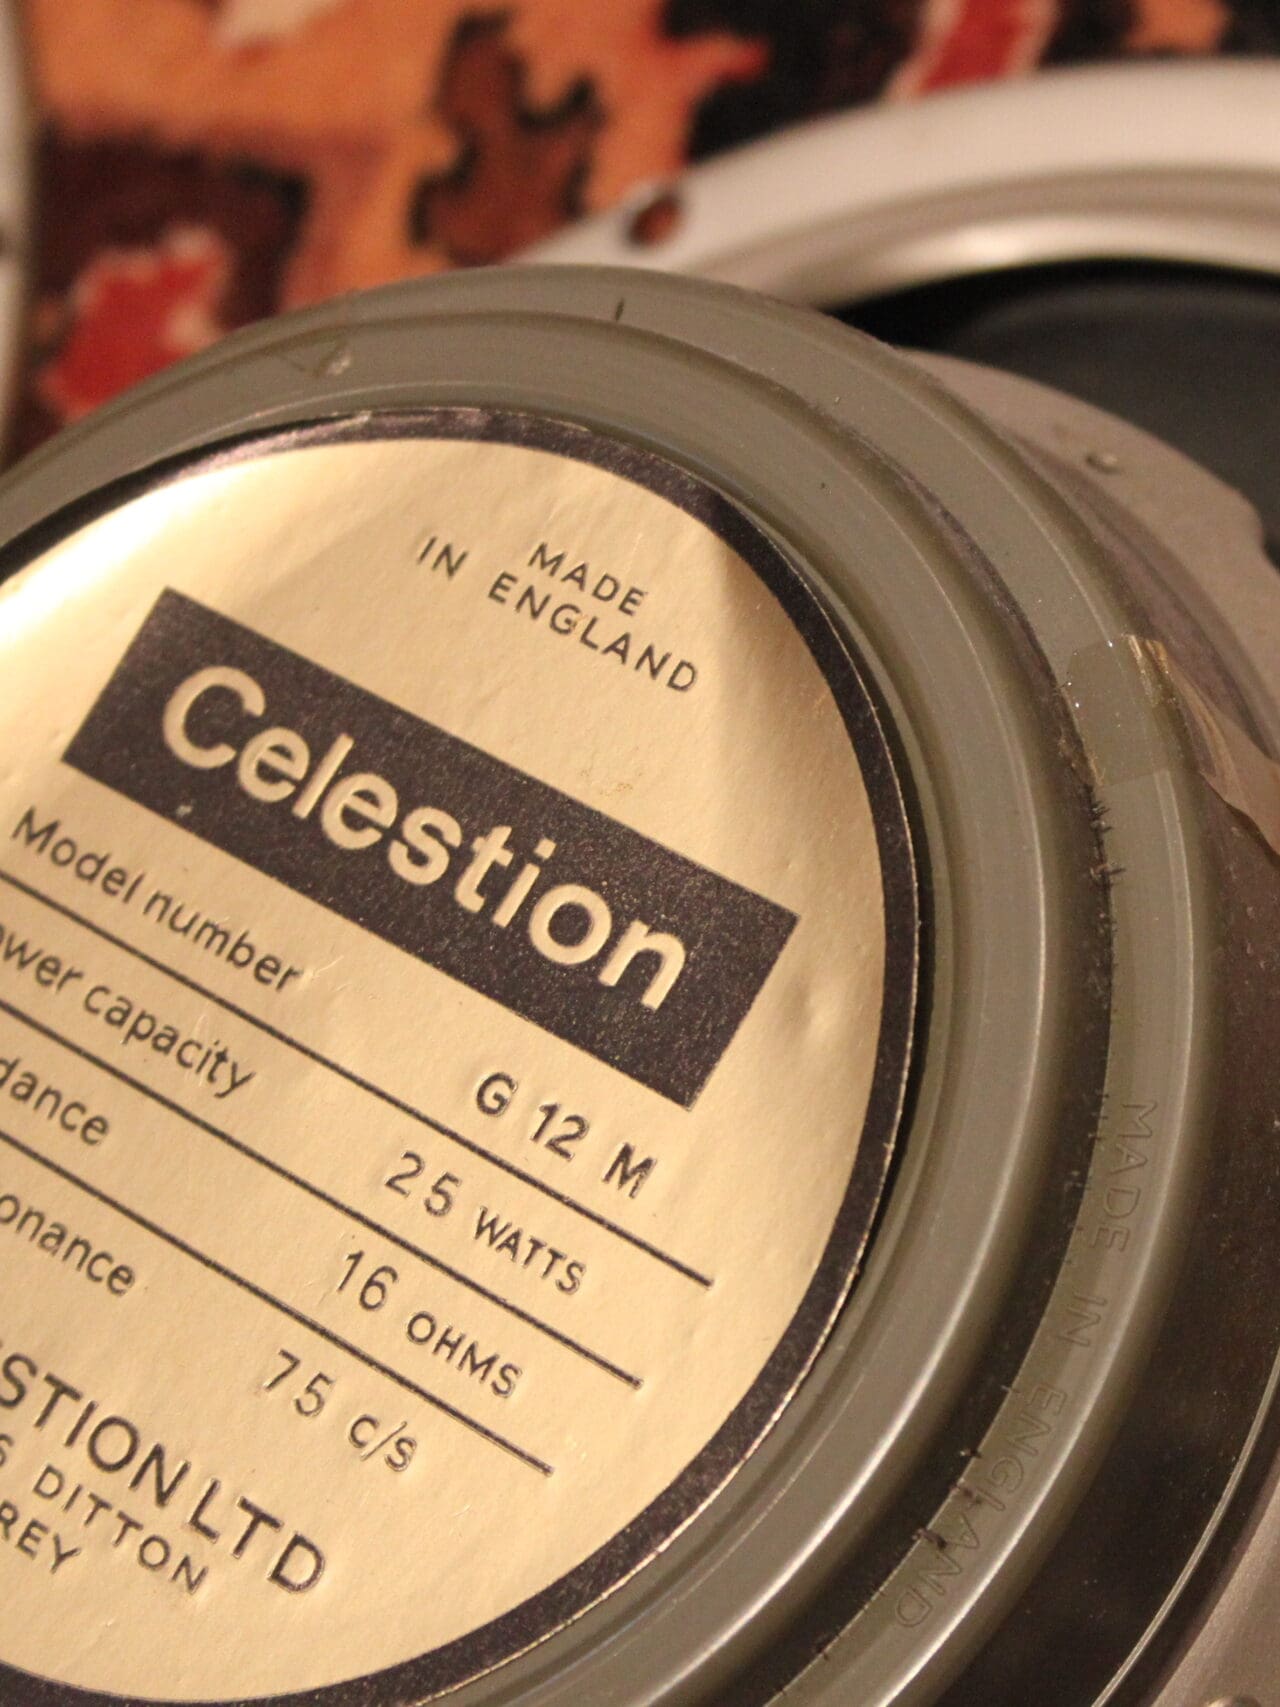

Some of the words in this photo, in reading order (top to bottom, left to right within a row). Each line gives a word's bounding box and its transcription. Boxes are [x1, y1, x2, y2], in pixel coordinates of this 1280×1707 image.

[417, 536, 468, 581] IN
[488, 571, 698, 692] ENGLAND
[528, 541, 648, 616] MADE
[162, 665, 687, 1011] Celestion
[11, 805, 146, 904] Model
[142, 889, 304, 992] number
[475, 1071, 518, 1117] G
[530, 1102, 590, 1162] 12
[601, 1142, 657, 1199] M
[0, 924, 84, 993] wer
[83, 984, 256, 1098] capacity
[384, 1151, 461, 1217] 25
[474, 1205, 587, 1294] WATTS
[1087, 1100, 1158, 1252] MADE
[263, 1349, 334, 1416] 75
[336, 1250, 398, 1311] 16
[405, 1310, 522, 1399] OHMS
[1061, 1293, 1107, 1349] IN
[0, 1340, 191, 1508] STION
[188, 1478, 326, 1593] LTD
[33, 1463, 208, 1595] DITTON
[895, 1383, 1068, 1628] ENGLAND
